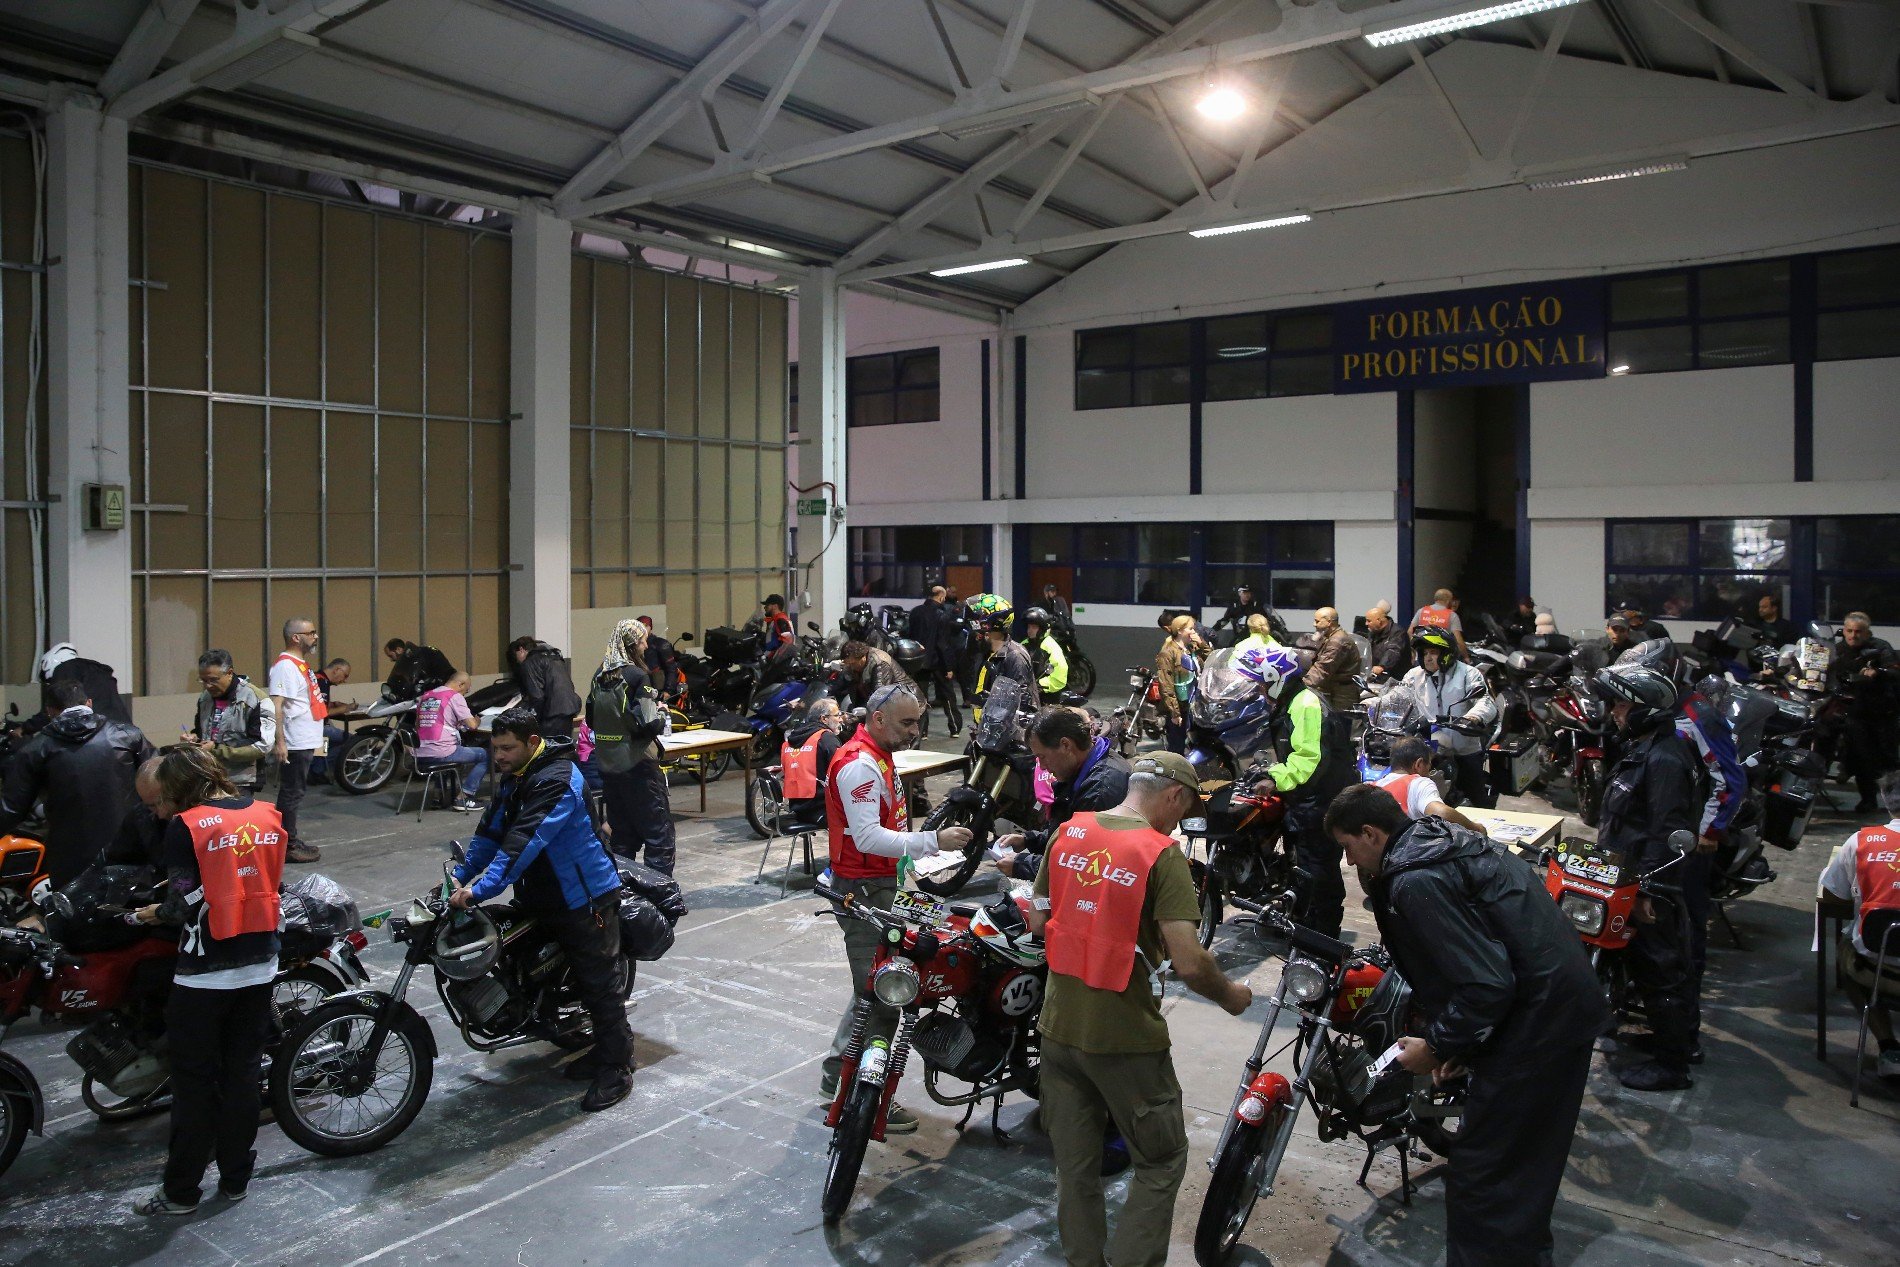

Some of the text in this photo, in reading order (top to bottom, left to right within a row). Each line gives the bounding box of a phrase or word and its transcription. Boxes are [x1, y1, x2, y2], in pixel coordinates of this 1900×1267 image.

[1367, 296, 1562, 342] FORMAÇÃO
[1343, 334, 1597, 381] PROFISSIONAL
[198, 815, 223, 828] ORG
[207, 833, 238, 852] LÉS
[254, 830, 279, 845] LÉS
[1066, 826, 1087, 839] ORG
[1866, 834, 1887, 842] ORG
[1866, 850, 1898, 862] LÉS
[1057, 852, 1089, 872] LÉS
[1101, 864, 1138, 887] LÉS
[61, 989, 88, 1007] V5
[1010, 979, 1033, 1008] V5
